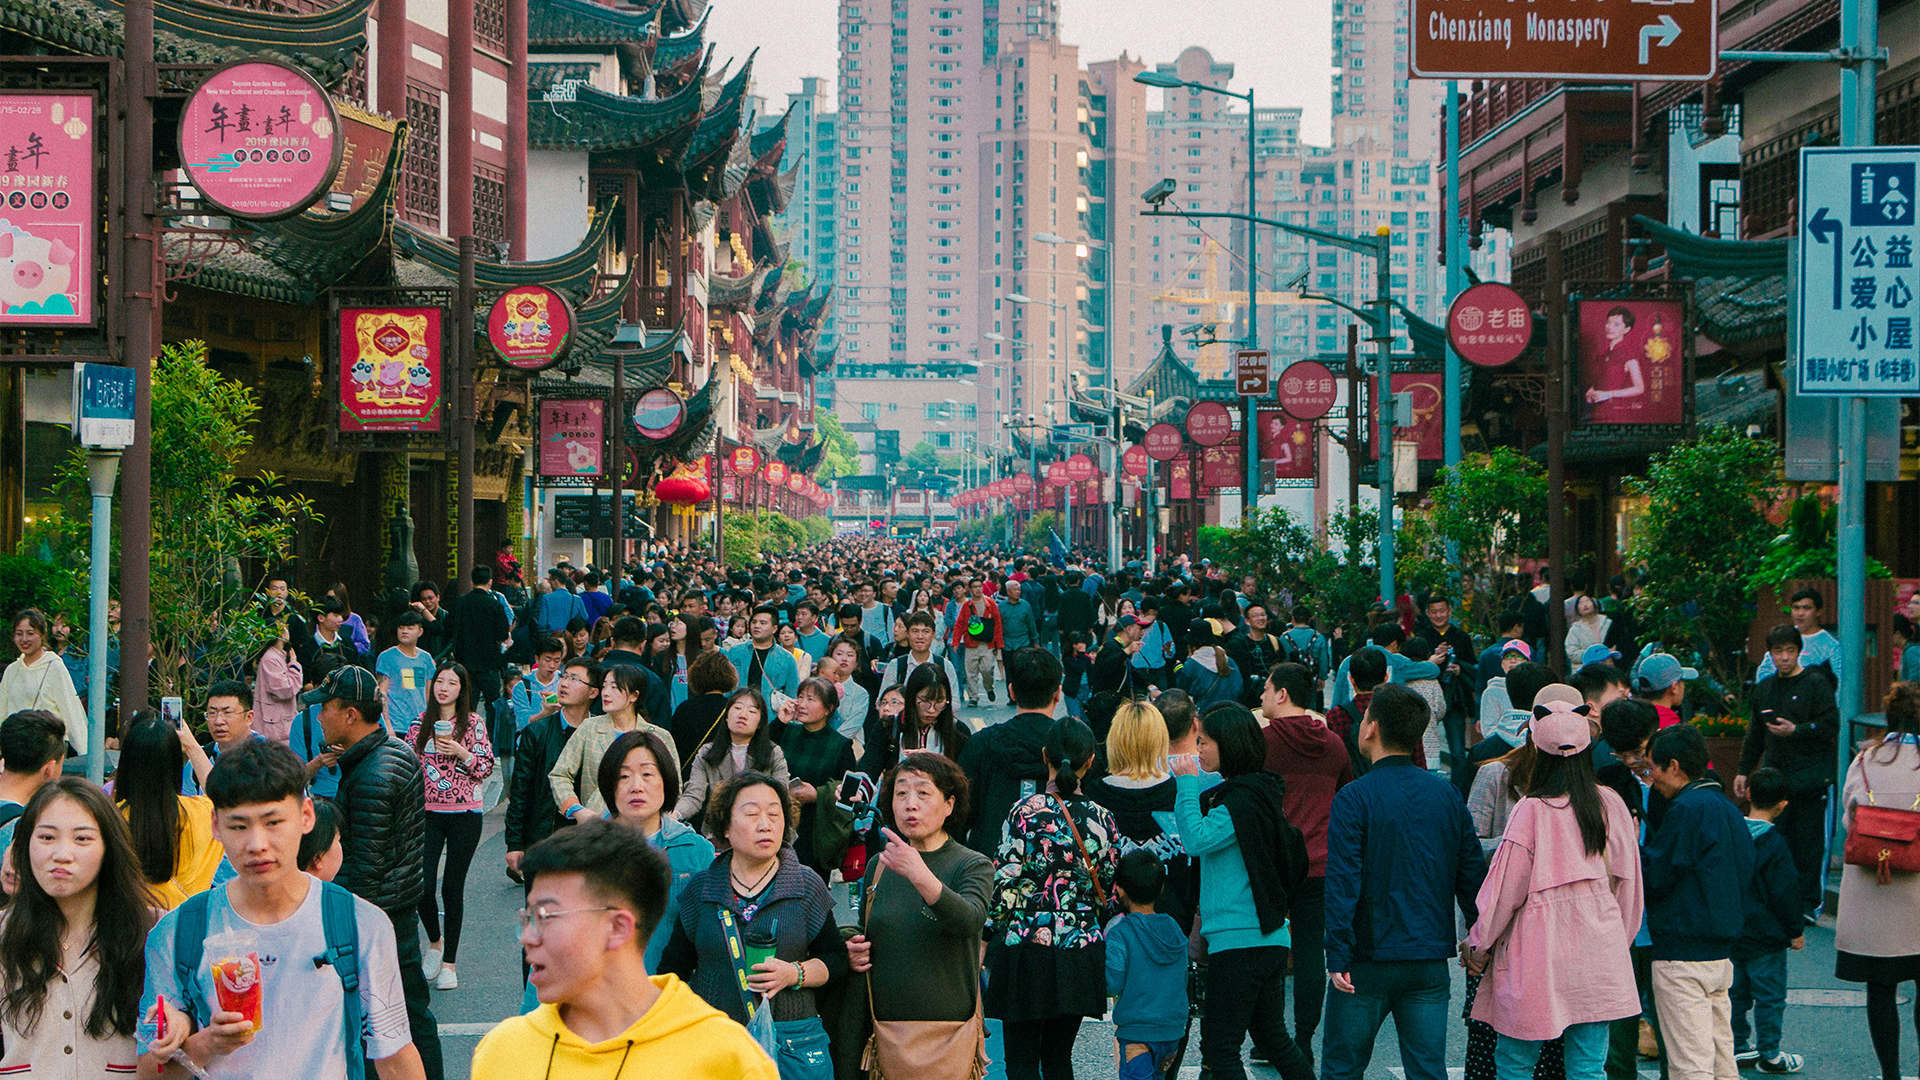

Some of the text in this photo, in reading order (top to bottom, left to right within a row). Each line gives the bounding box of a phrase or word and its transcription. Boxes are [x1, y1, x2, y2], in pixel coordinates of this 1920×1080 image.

[1429, 10, 1609, 50] Chenxiang Monaspery
[245, 137, 267, 147] 2019
[1850, 234, 1914, 268] 公益
[1850, 275, 1914, 310] 爱心
[1487, 307, 1525, 329] 老庙
[1850, 316, 1913, 350] 小屋
[1303, 378, 1332, 393] 老庙
[429, 787, 460, 799] FEED
